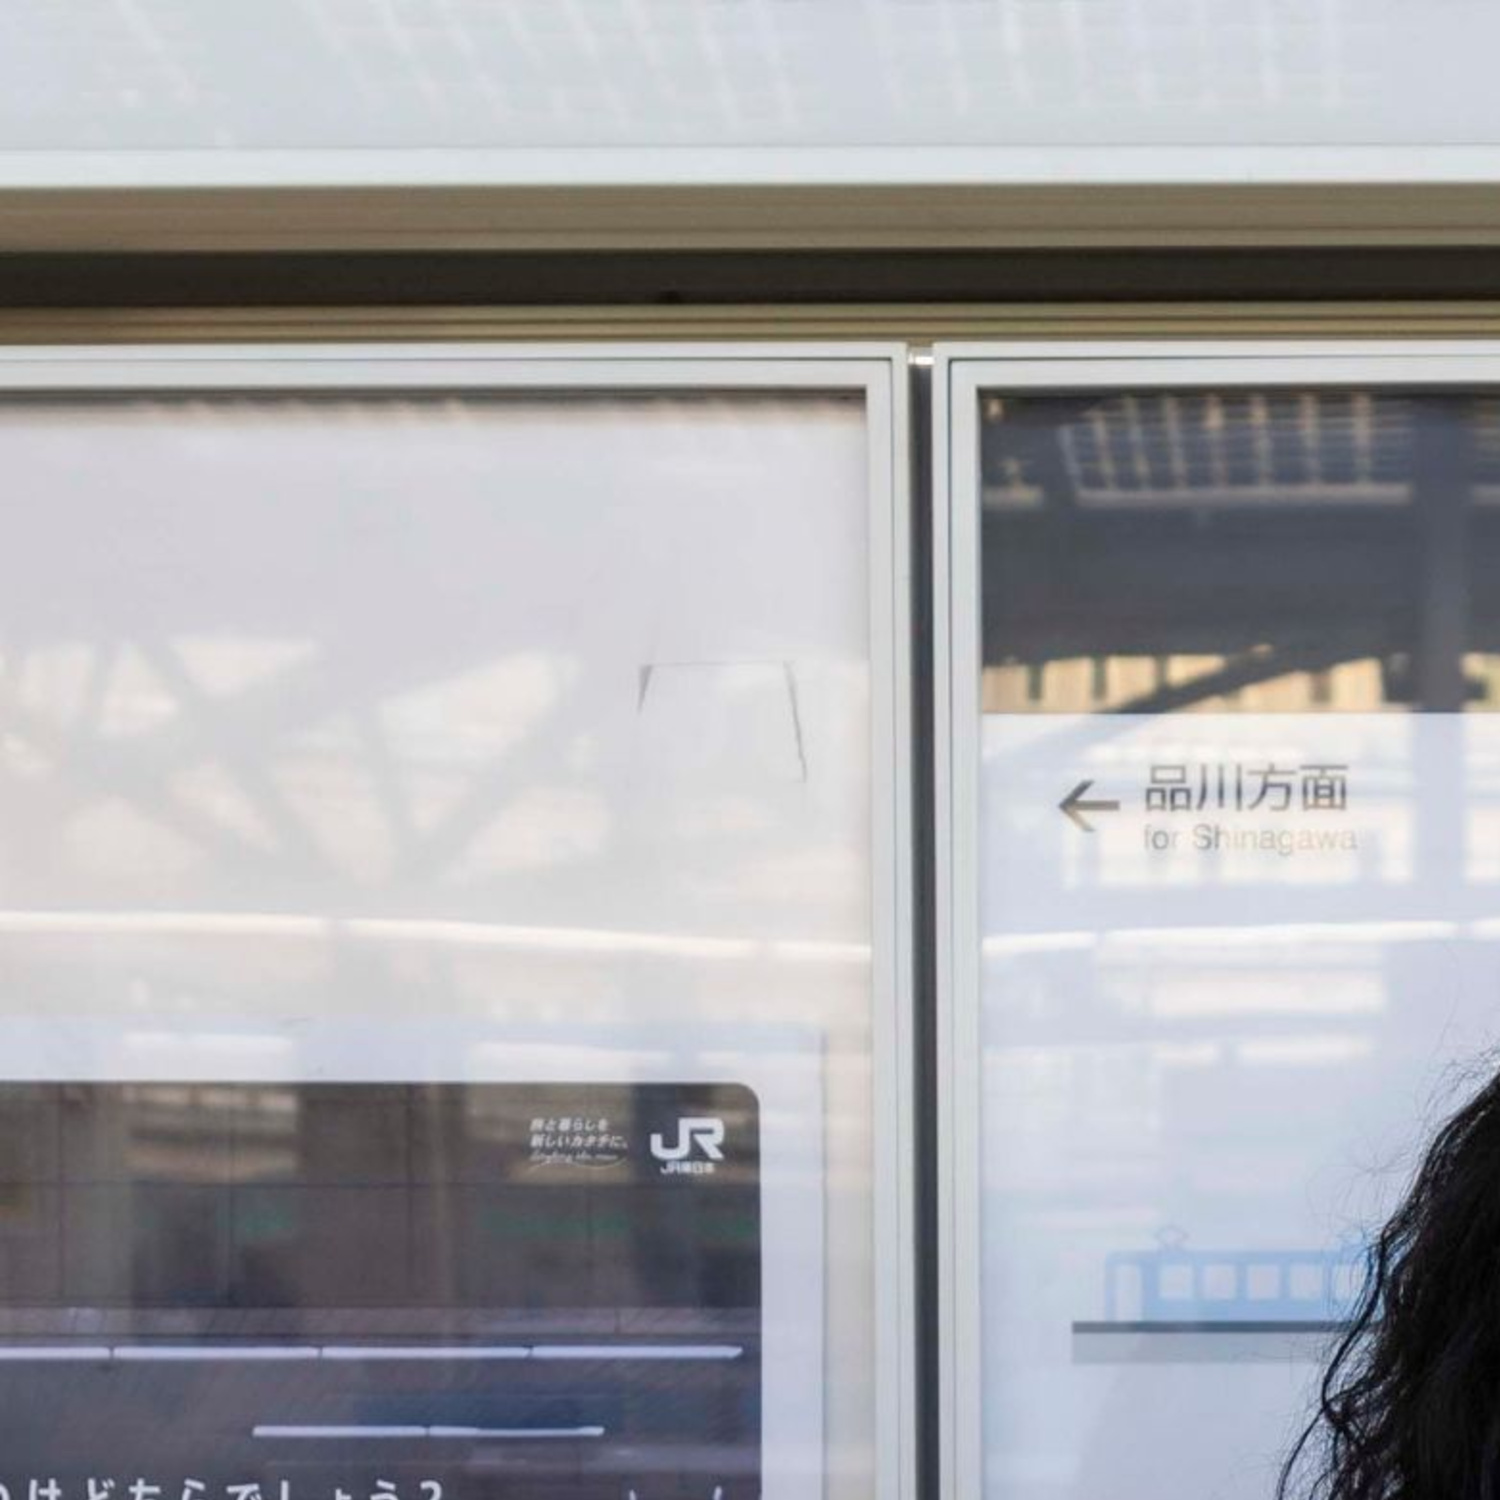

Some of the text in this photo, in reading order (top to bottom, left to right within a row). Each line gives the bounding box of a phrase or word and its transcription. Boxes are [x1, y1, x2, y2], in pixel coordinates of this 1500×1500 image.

[1145, 763, 1348, 811] 品川方面
[1144, 824, 1358, 855] for Shinagawa
[650, 1117, 724, 1159] JR
